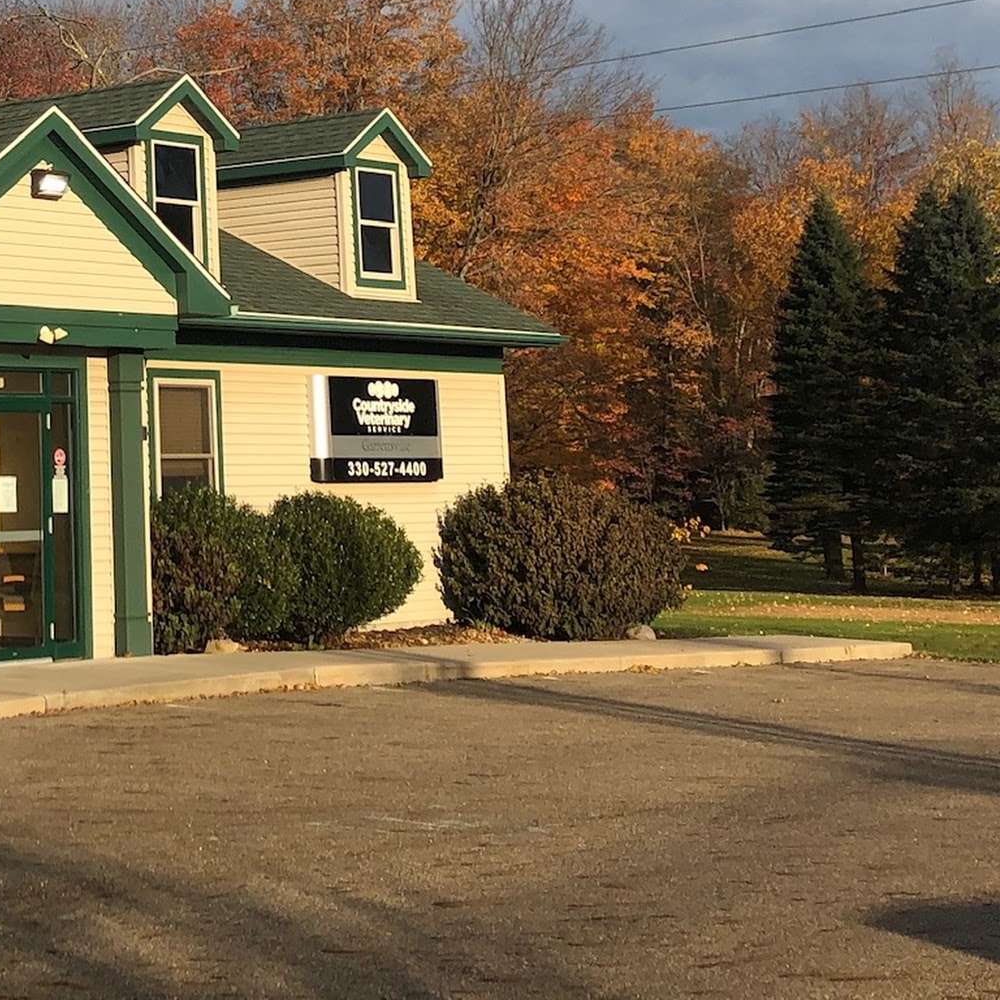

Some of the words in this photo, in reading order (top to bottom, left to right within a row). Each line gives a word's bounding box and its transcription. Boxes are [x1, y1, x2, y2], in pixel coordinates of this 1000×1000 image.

[352, 397, 416, 414] Countryside
[356, 409, 411, 429] Veterinary
[347, 461, 427, 476] 330-527-4400
